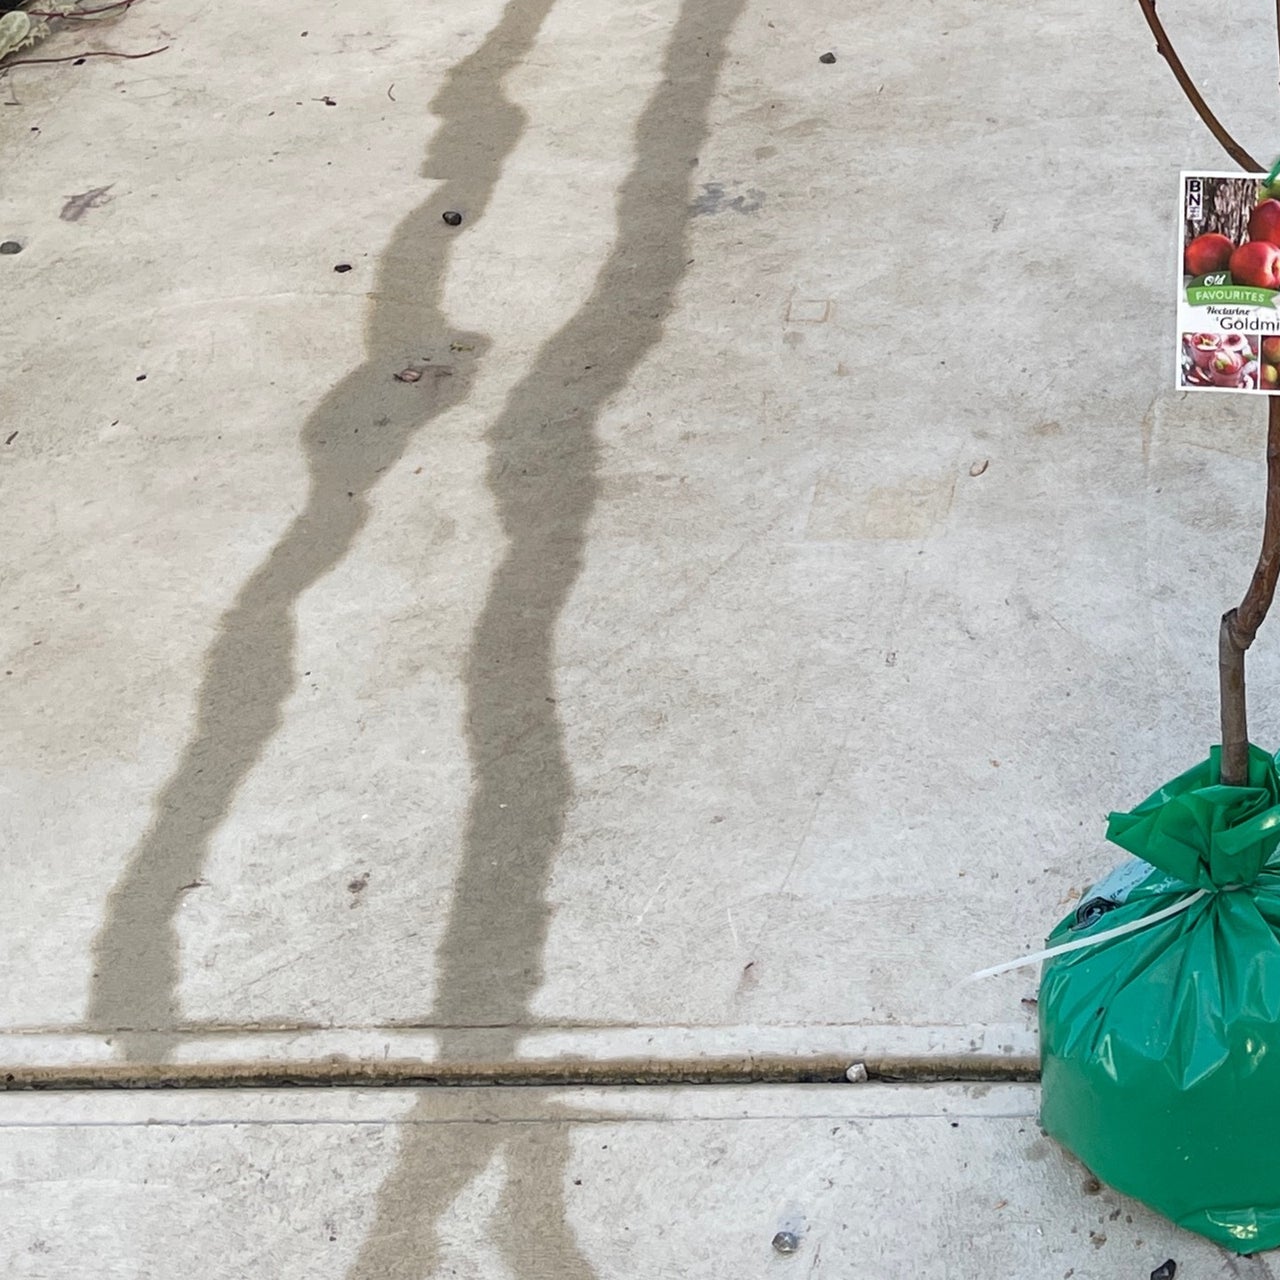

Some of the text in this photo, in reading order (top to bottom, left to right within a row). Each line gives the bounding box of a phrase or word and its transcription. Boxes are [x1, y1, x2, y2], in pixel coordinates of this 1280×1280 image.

[1204, 274, 1226, 286] Old
[1196, 290, 1265, 303] FAVOURITES
[1206, 306, 1251, 316] Nectarine
